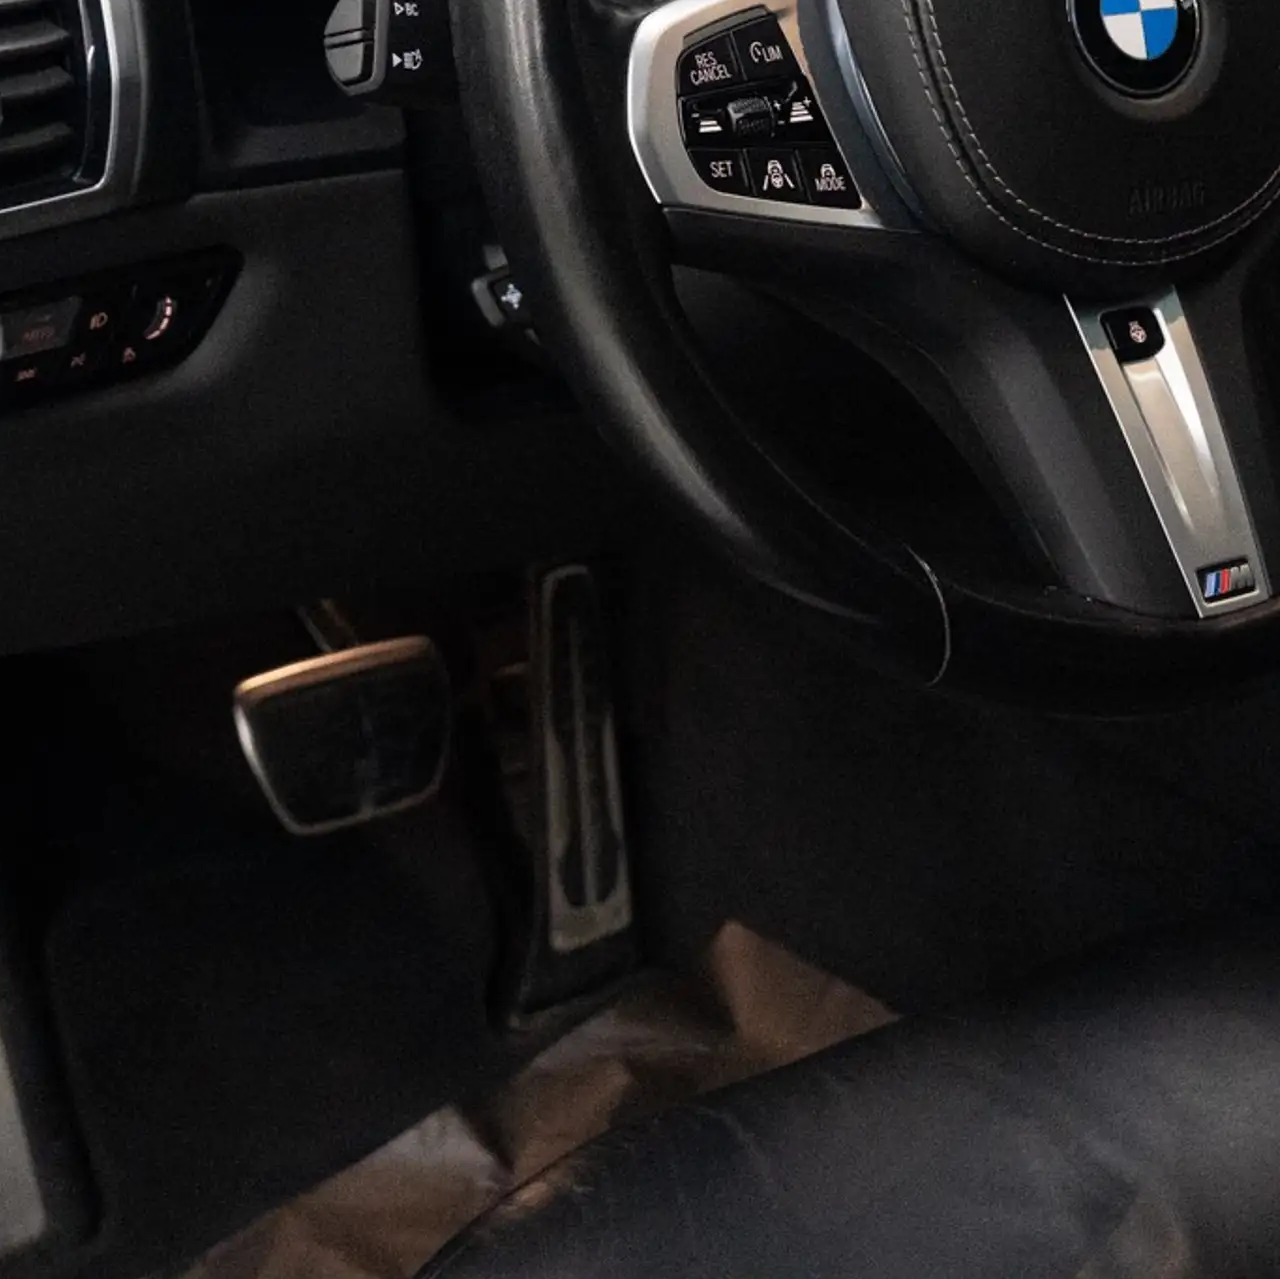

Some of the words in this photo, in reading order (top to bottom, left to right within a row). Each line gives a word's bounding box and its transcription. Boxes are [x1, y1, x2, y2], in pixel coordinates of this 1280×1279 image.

[695, 51, 717, 68] RES
[763, 46, 783, 63] LIM
[690, 63, 732, 86] CANCEL
[710, 160, 734, 178] SET
[815, 175, 846, 192] MODE
